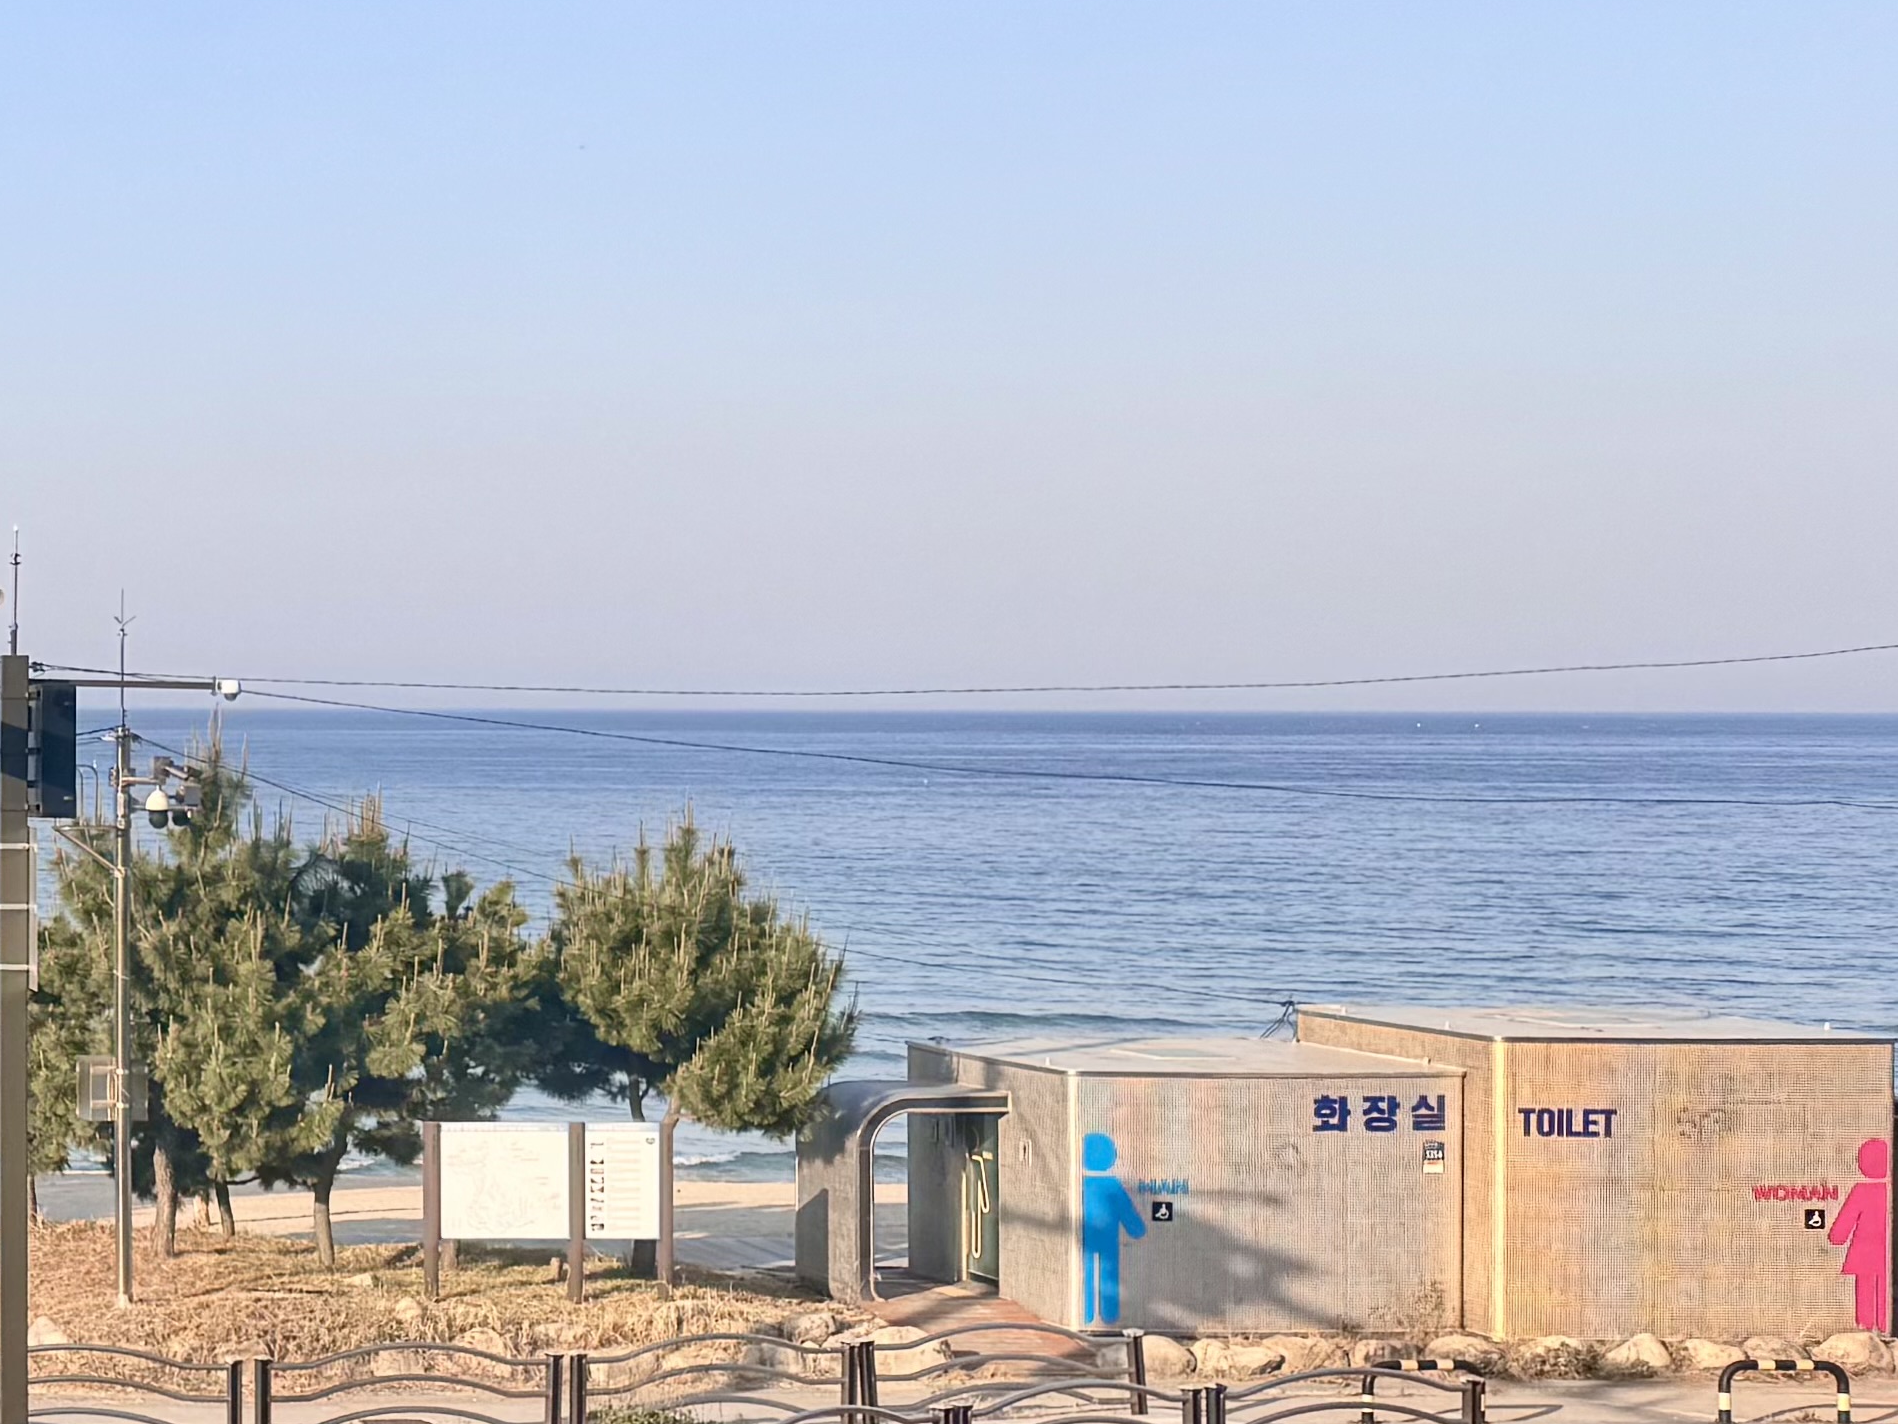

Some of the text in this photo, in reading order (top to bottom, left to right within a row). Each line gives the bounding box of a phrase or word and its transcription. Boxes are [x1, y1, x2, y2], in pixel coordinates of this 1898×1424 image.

[1311, 1092, 1446, 1133] 화장실
[1517, 1106, 1619, 1139] TOILET
[1751, 1183, 1839, 1202] WOMAN
